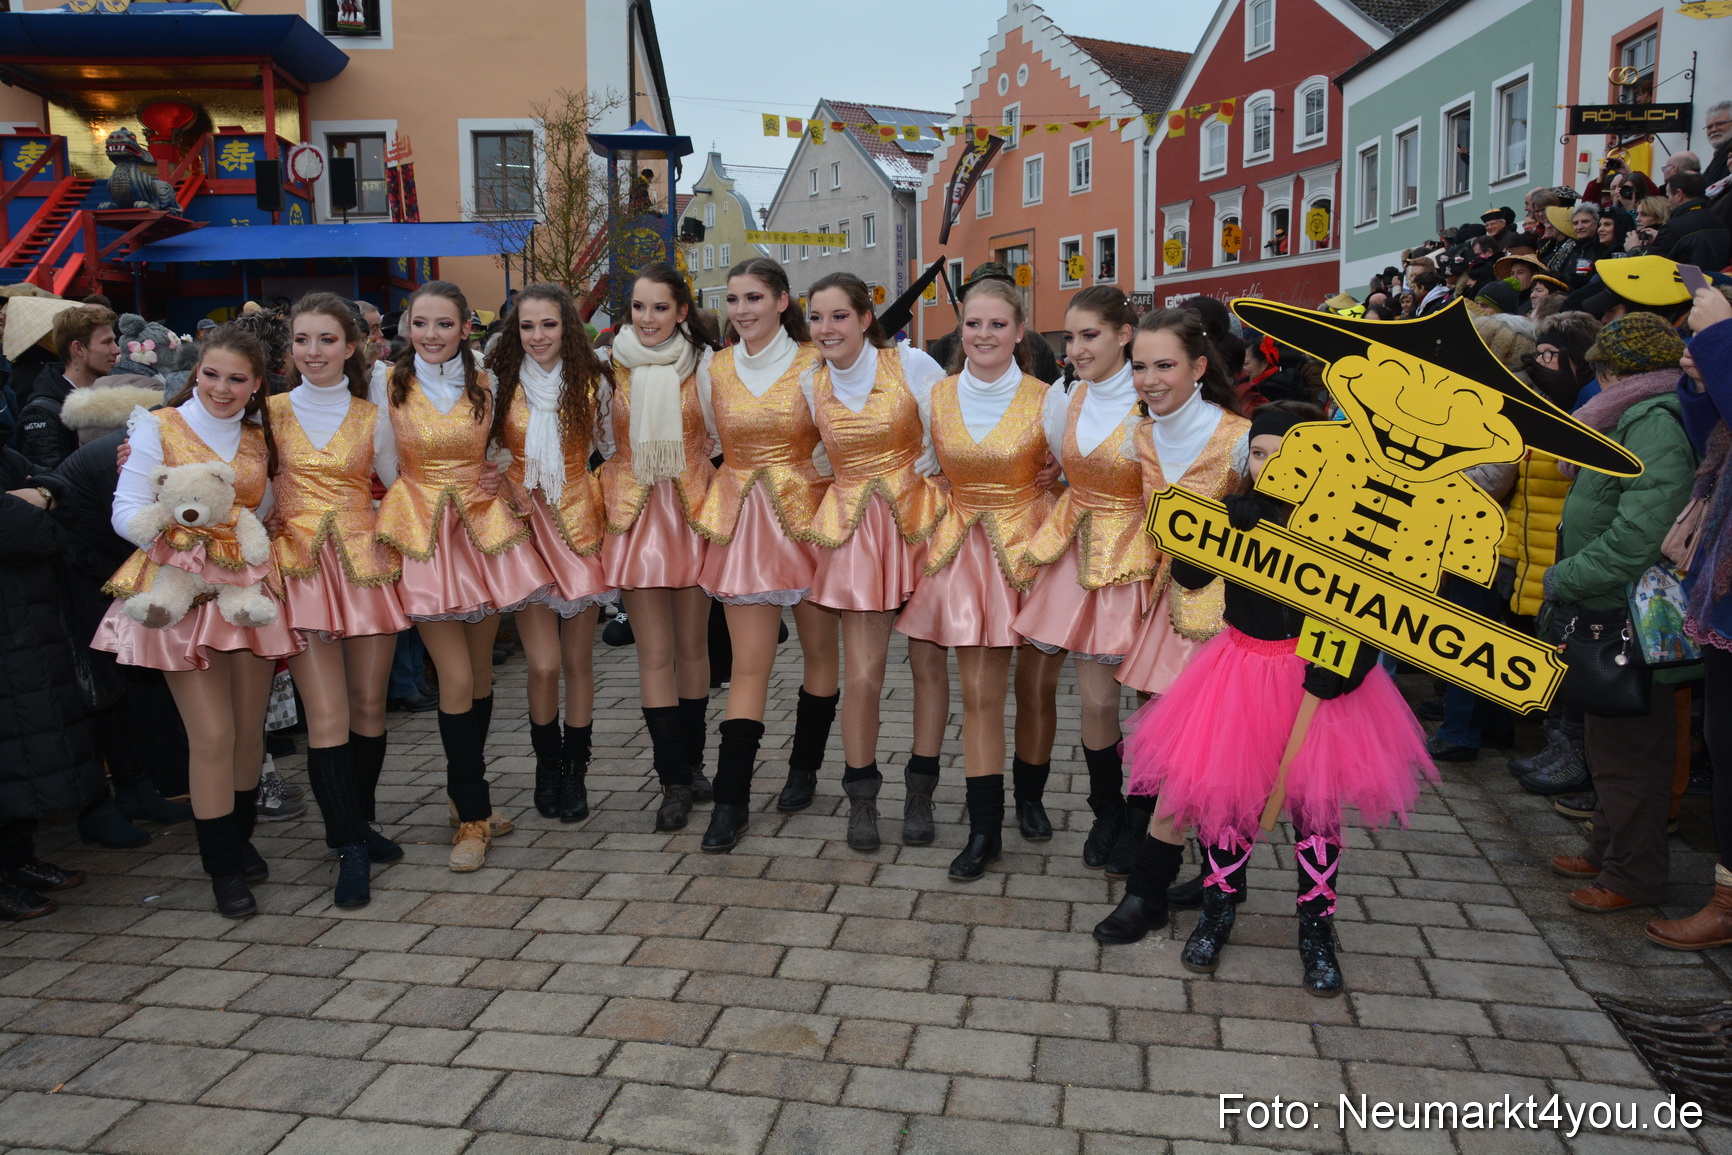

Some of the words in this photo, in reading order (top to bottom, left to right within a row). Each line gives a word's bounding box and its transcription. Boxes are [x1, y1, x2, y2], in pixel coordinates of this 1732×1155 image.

[1582, 109, 1679, 122] RÖHLICH
[1132, 294, 1151, 305] CAFÉ
[1165, 292, 1201, 310] GÖT
[1168, 508, 1537, 691] CHIMICHANGAS
[1310, 630, 1347, 668] 11
